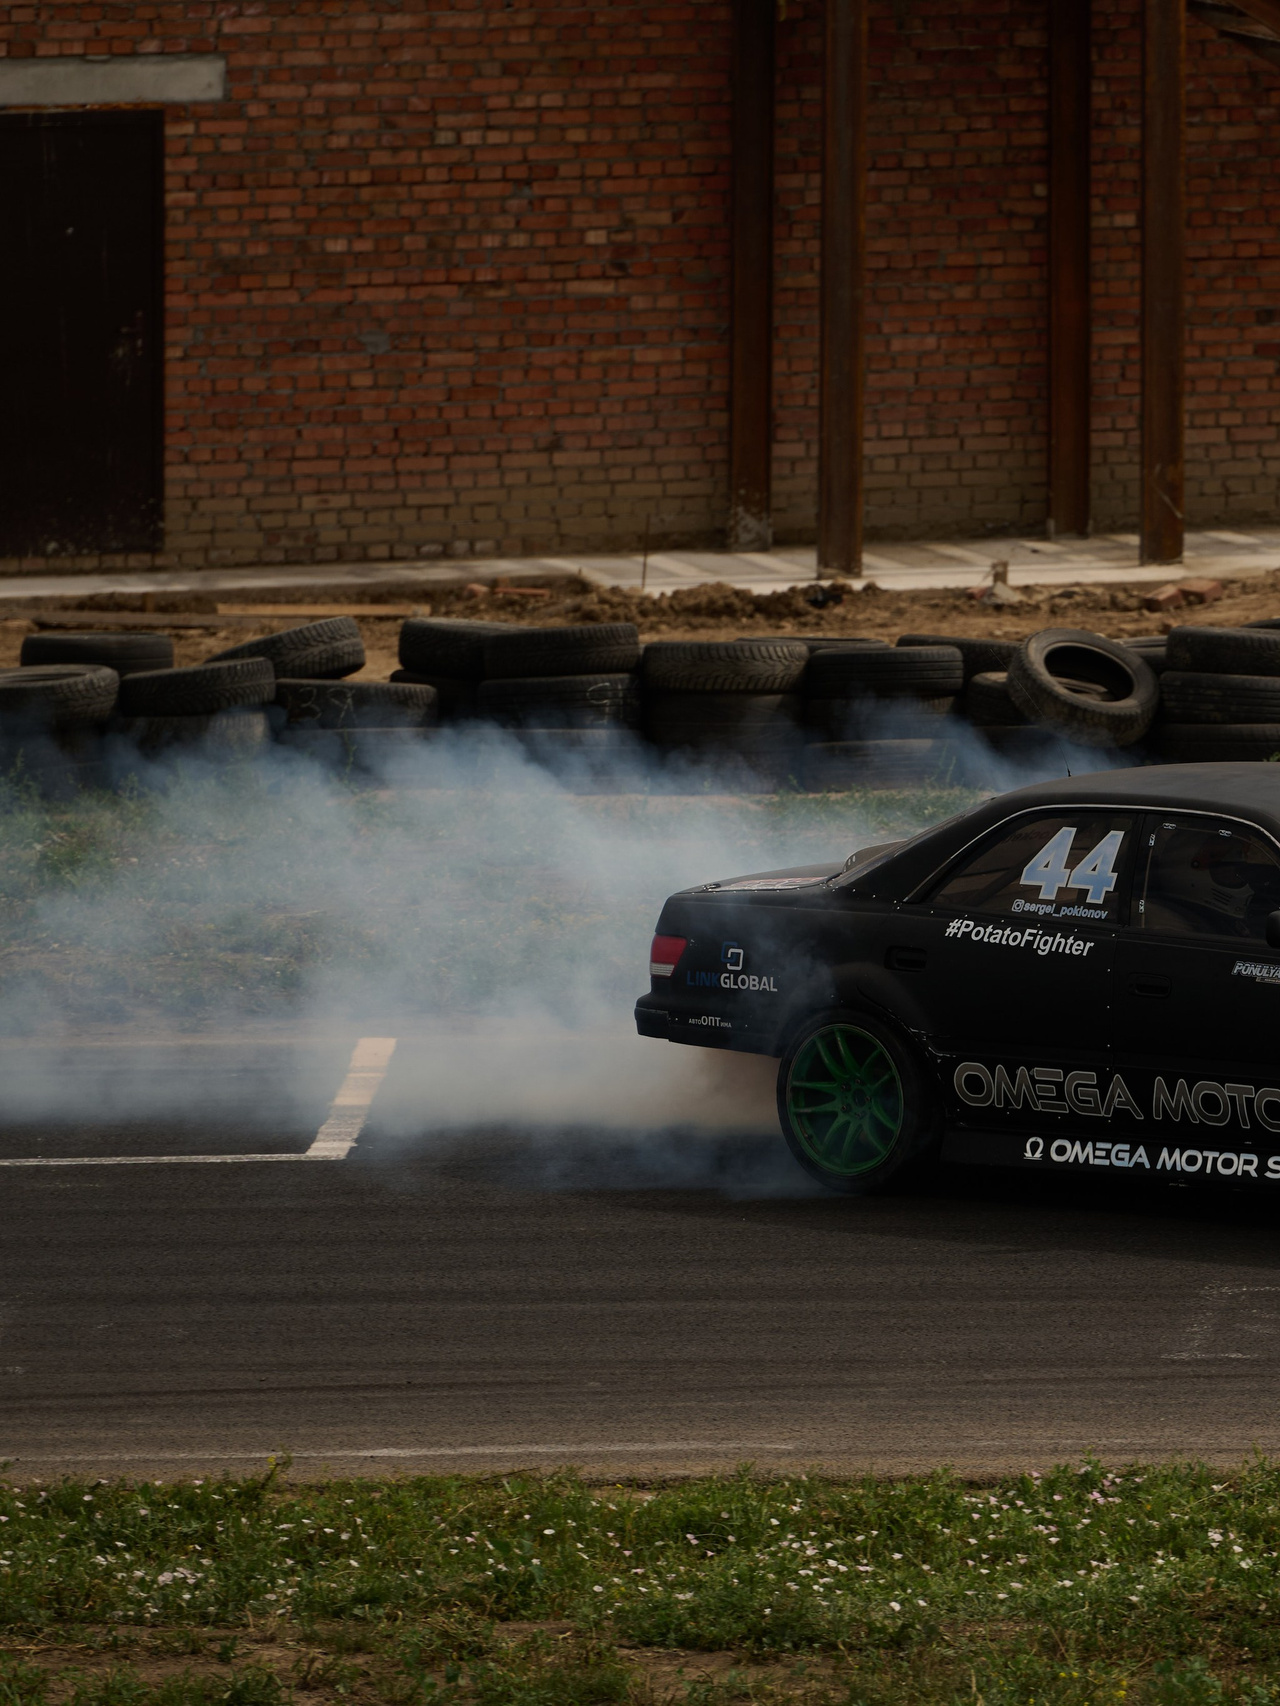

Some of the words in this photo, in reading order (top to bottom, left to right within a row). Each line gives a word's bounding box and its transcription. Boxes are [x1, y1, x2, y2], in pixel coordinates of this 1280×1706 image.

[1019, 826, 1125, 904] 44
[945, 919, 1095, 957] #PotatoFighter
[953, 1062, 1145, 1121] OMEGA
[1050, 1138, 1151, 1170] OMEGA
[1155, 1146, 1259, 1178] MOTOR
